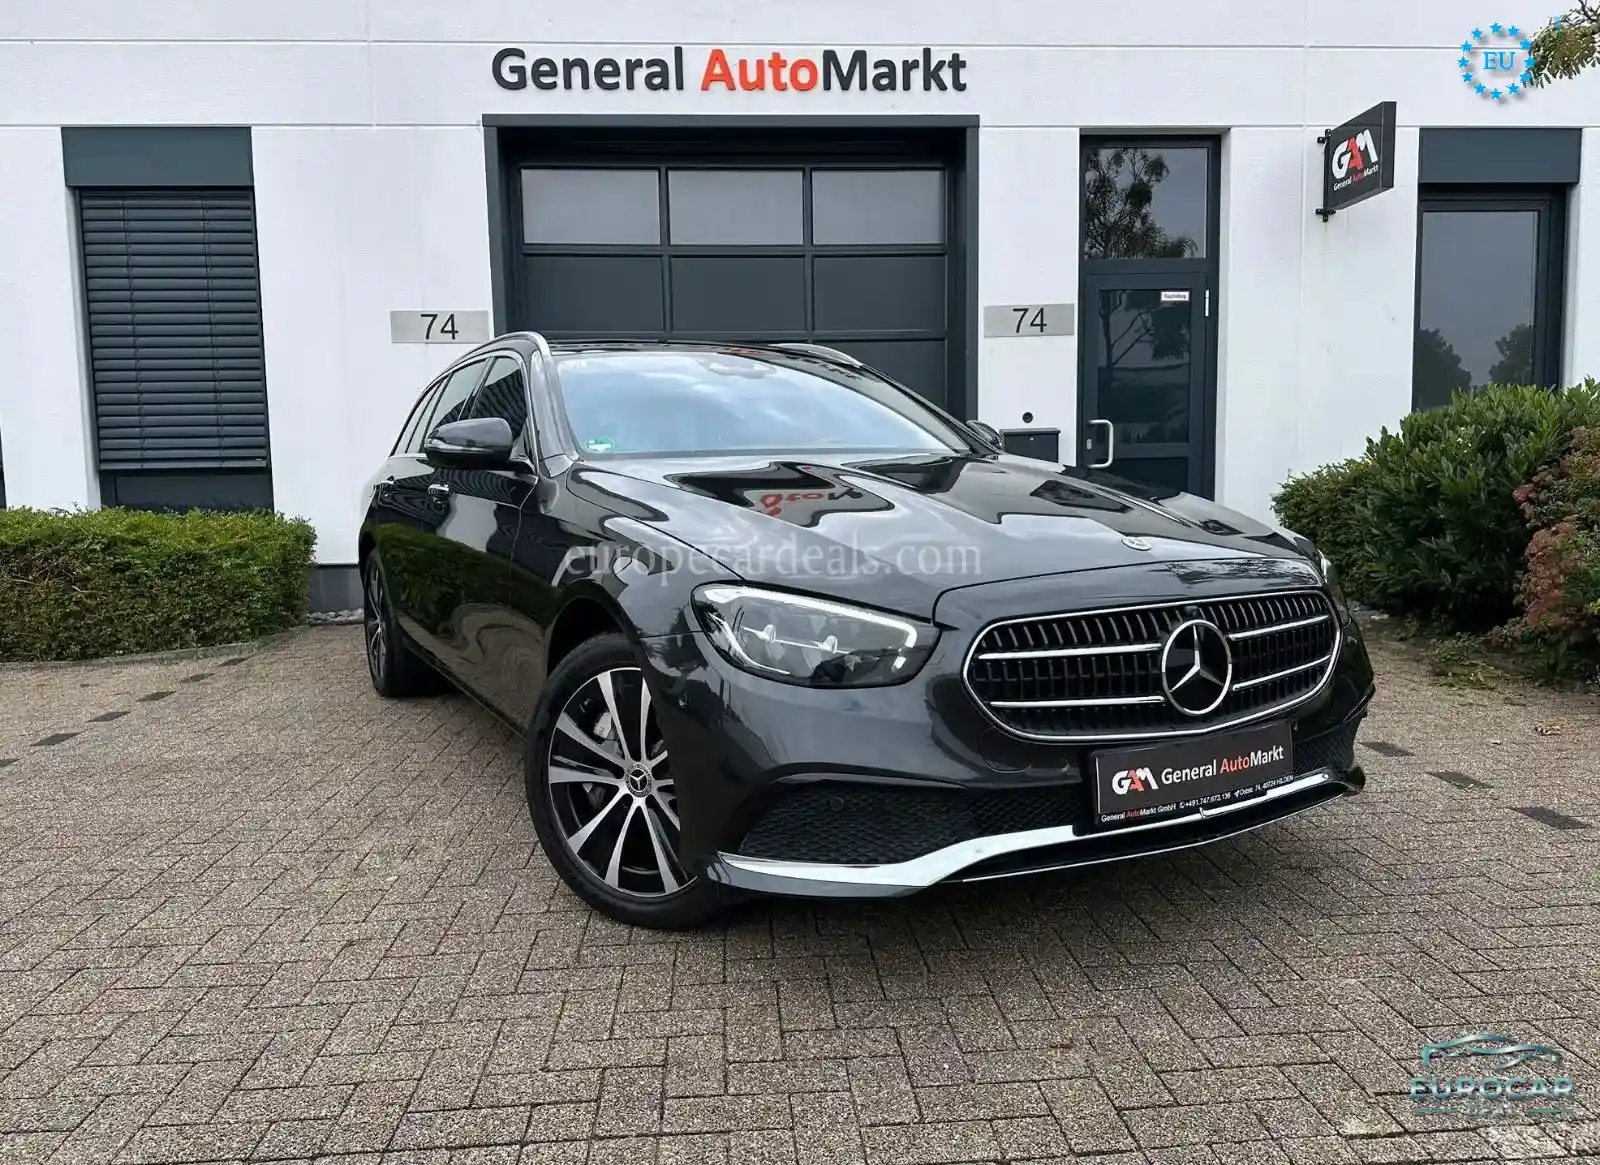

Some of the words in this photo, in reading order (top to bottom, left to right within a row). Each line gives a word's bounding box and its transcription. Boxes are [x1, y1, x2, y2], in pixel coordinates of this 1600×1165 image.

[491, 46, 684, 91] General
[700, 47, 967, 91] AutoMarkt
[1332, 129, 1379, 179] GAM
[1333, 176, 1352, 191] General
[420, 313, 459, 340] 74
[1013, 307, 1047, 333] 74
[1111, 767, 1159, 795] GAM
[1161, 759, 1217, 785] General
[1220, 745, 1284, 774] AutoMarkt
[1101, 812, 1125, 822] General
